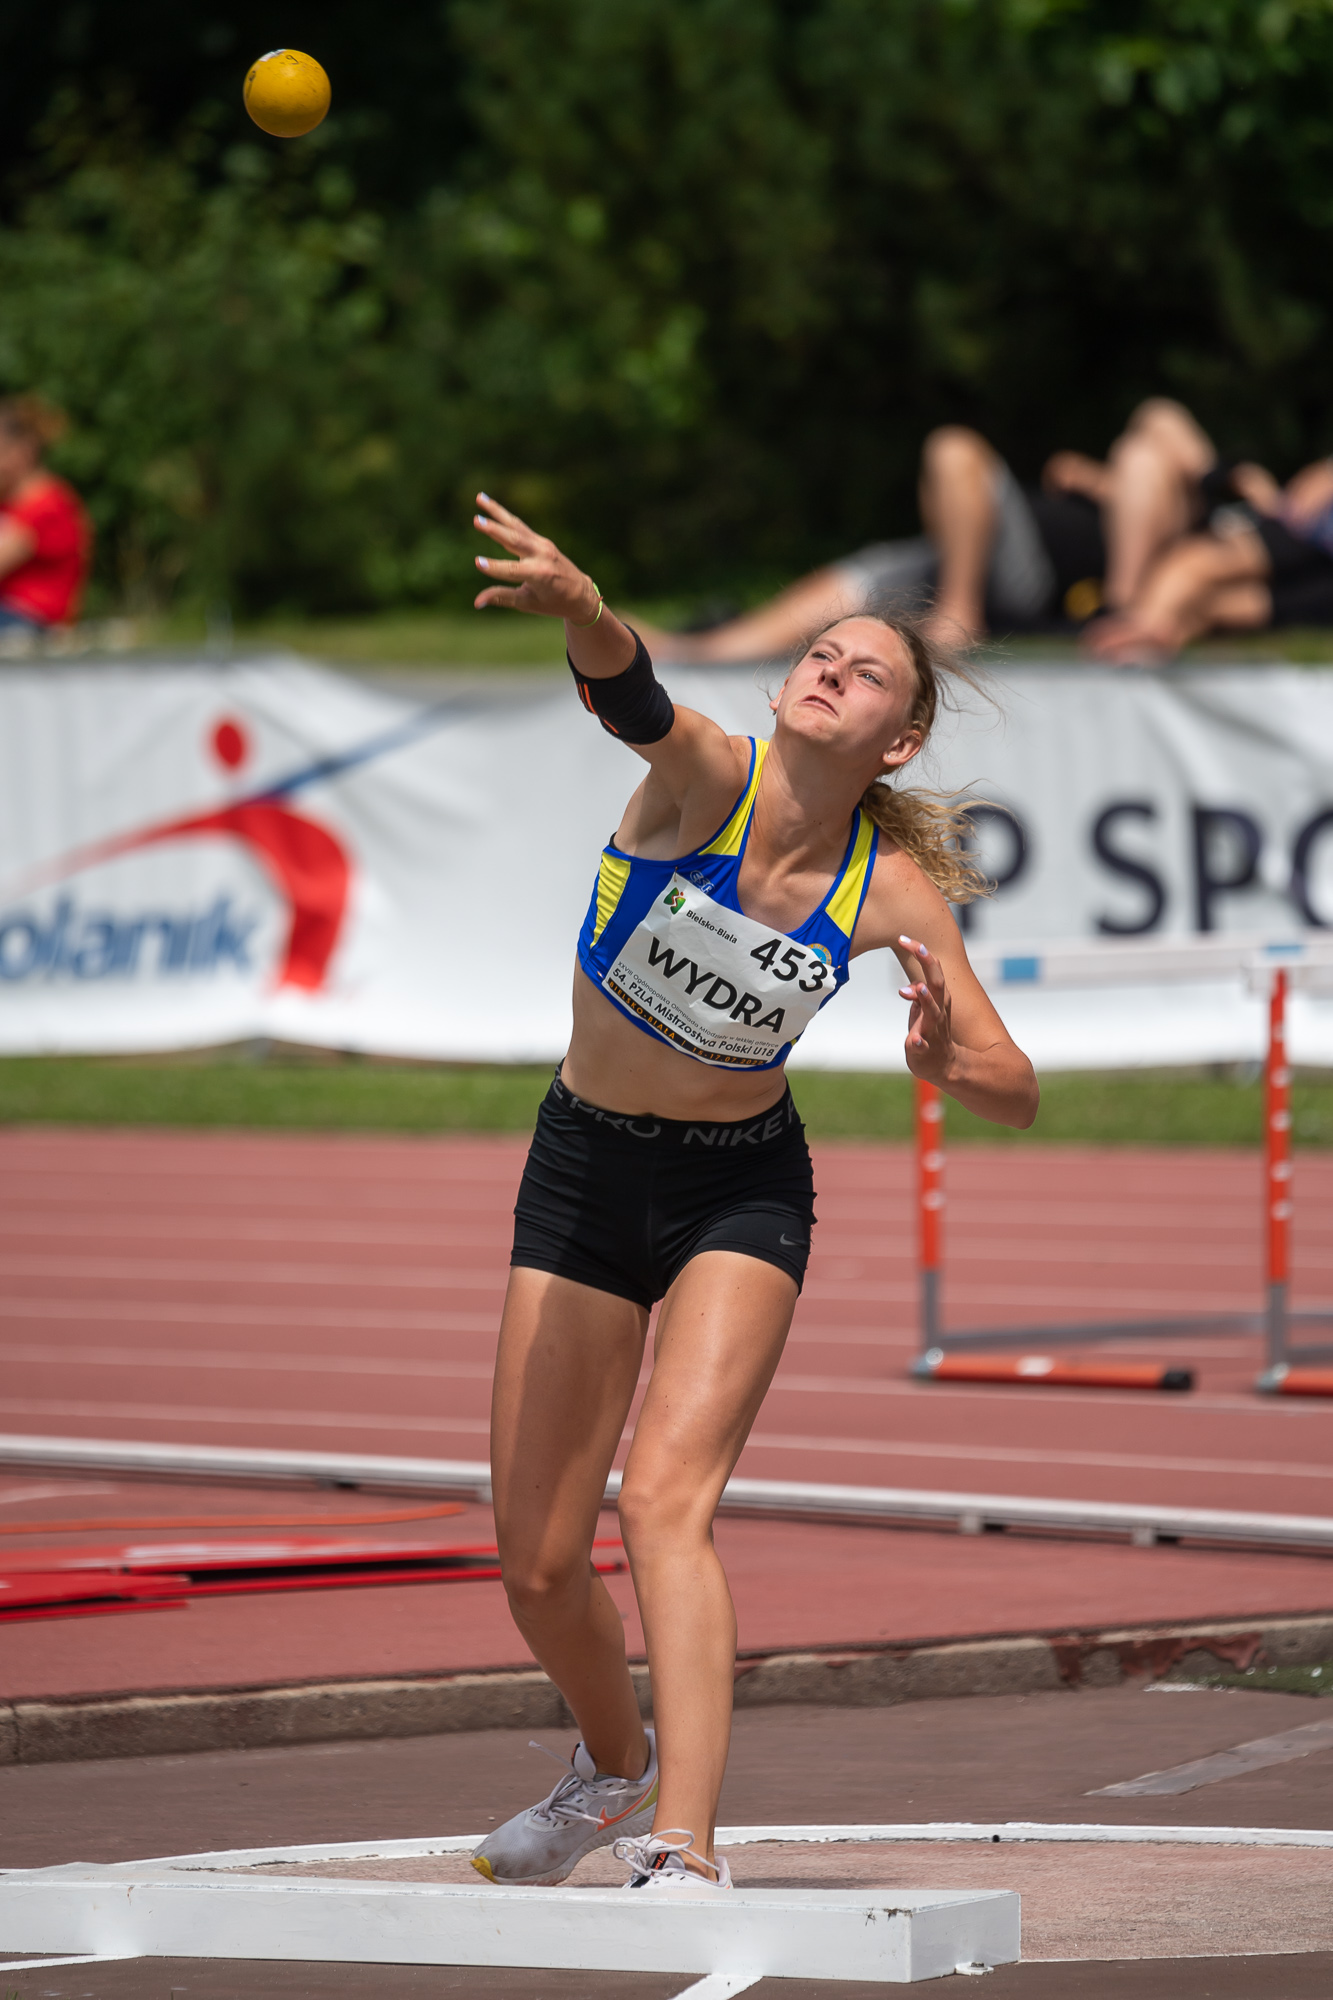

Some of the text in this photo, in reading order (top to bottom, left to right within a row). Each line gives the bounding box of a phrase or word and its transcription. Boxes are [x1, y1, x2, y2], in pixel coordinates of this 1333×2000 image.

[647, 936, 786, 1034] WYDRA
[750, 938, 828, 993] 453
[613, 968, 775, 1057] 54. PZLA Mistrzostwa Polski U18
[634, 974, 671, 1005] Ogólnopolska
[671, 1003, 699, 1028] Olimpiada
[736, 1036, 755, 1045] lekkiej
[755, 1041, 780, 1049] atletyce
[682, 1109, 784, 1147] NIKE
